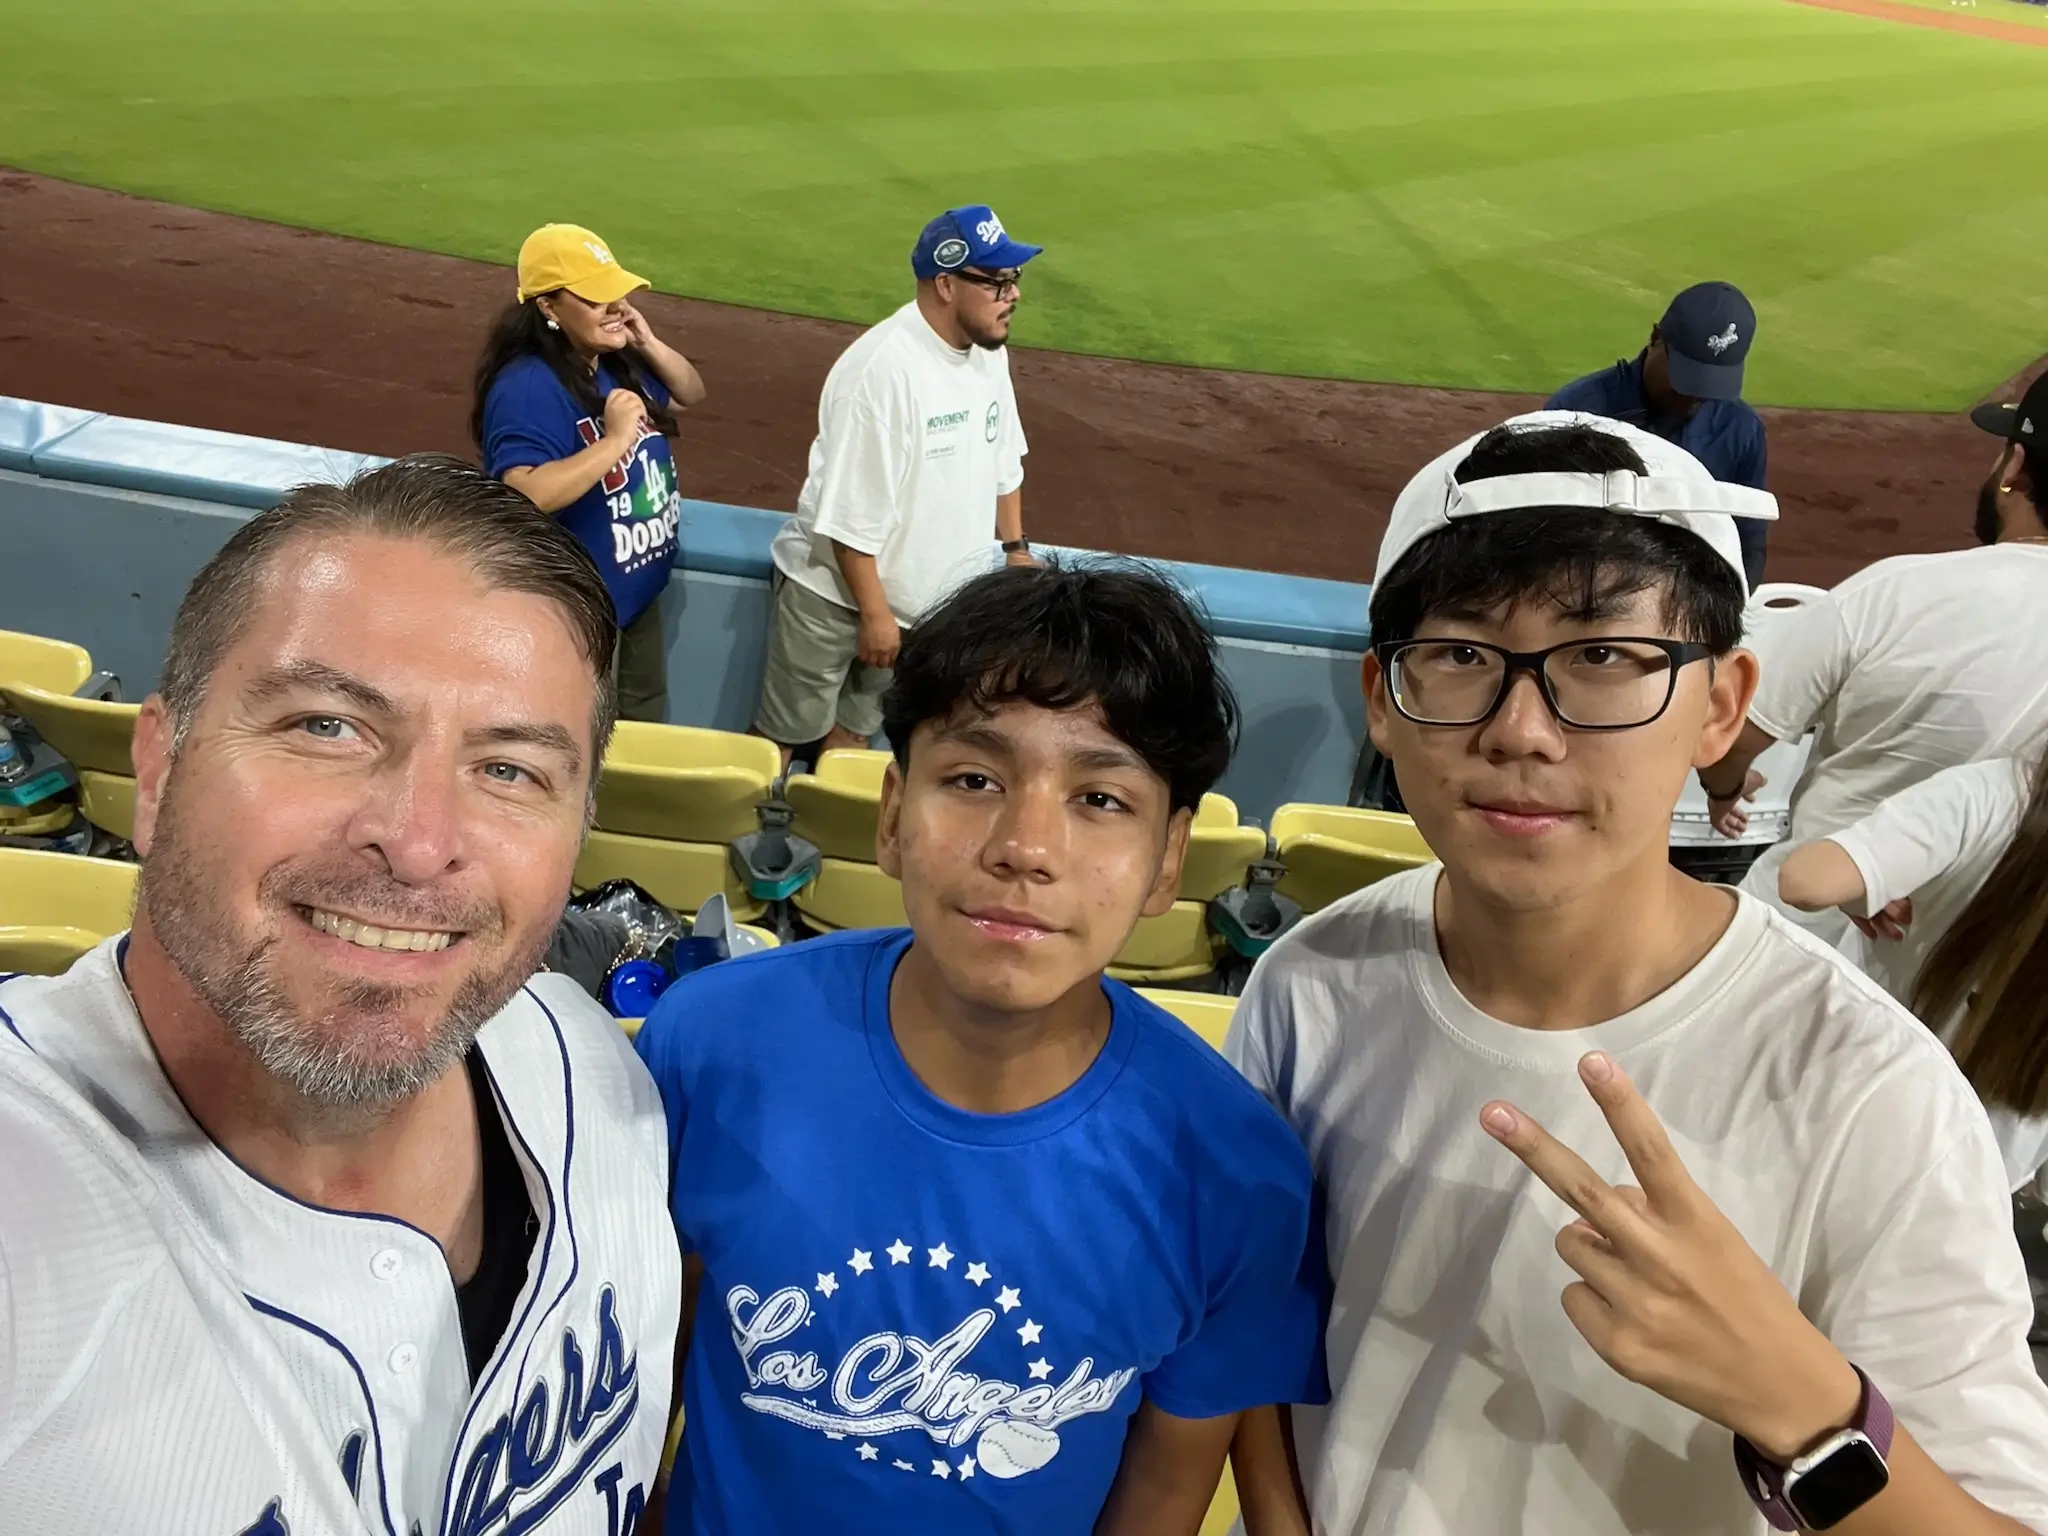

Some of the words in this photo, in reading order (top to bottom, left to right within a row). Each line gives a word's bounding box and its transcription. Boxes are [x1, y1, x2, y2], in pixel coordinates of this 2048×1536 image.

[926, 410, 970, 430] MOVEMENT
[637, 449, 669, 514] LA
[606, 491, 632, 520] 19
[726, 1284, 828, 1389] Los
[831, 1308, 1138, 1447] Angeles
